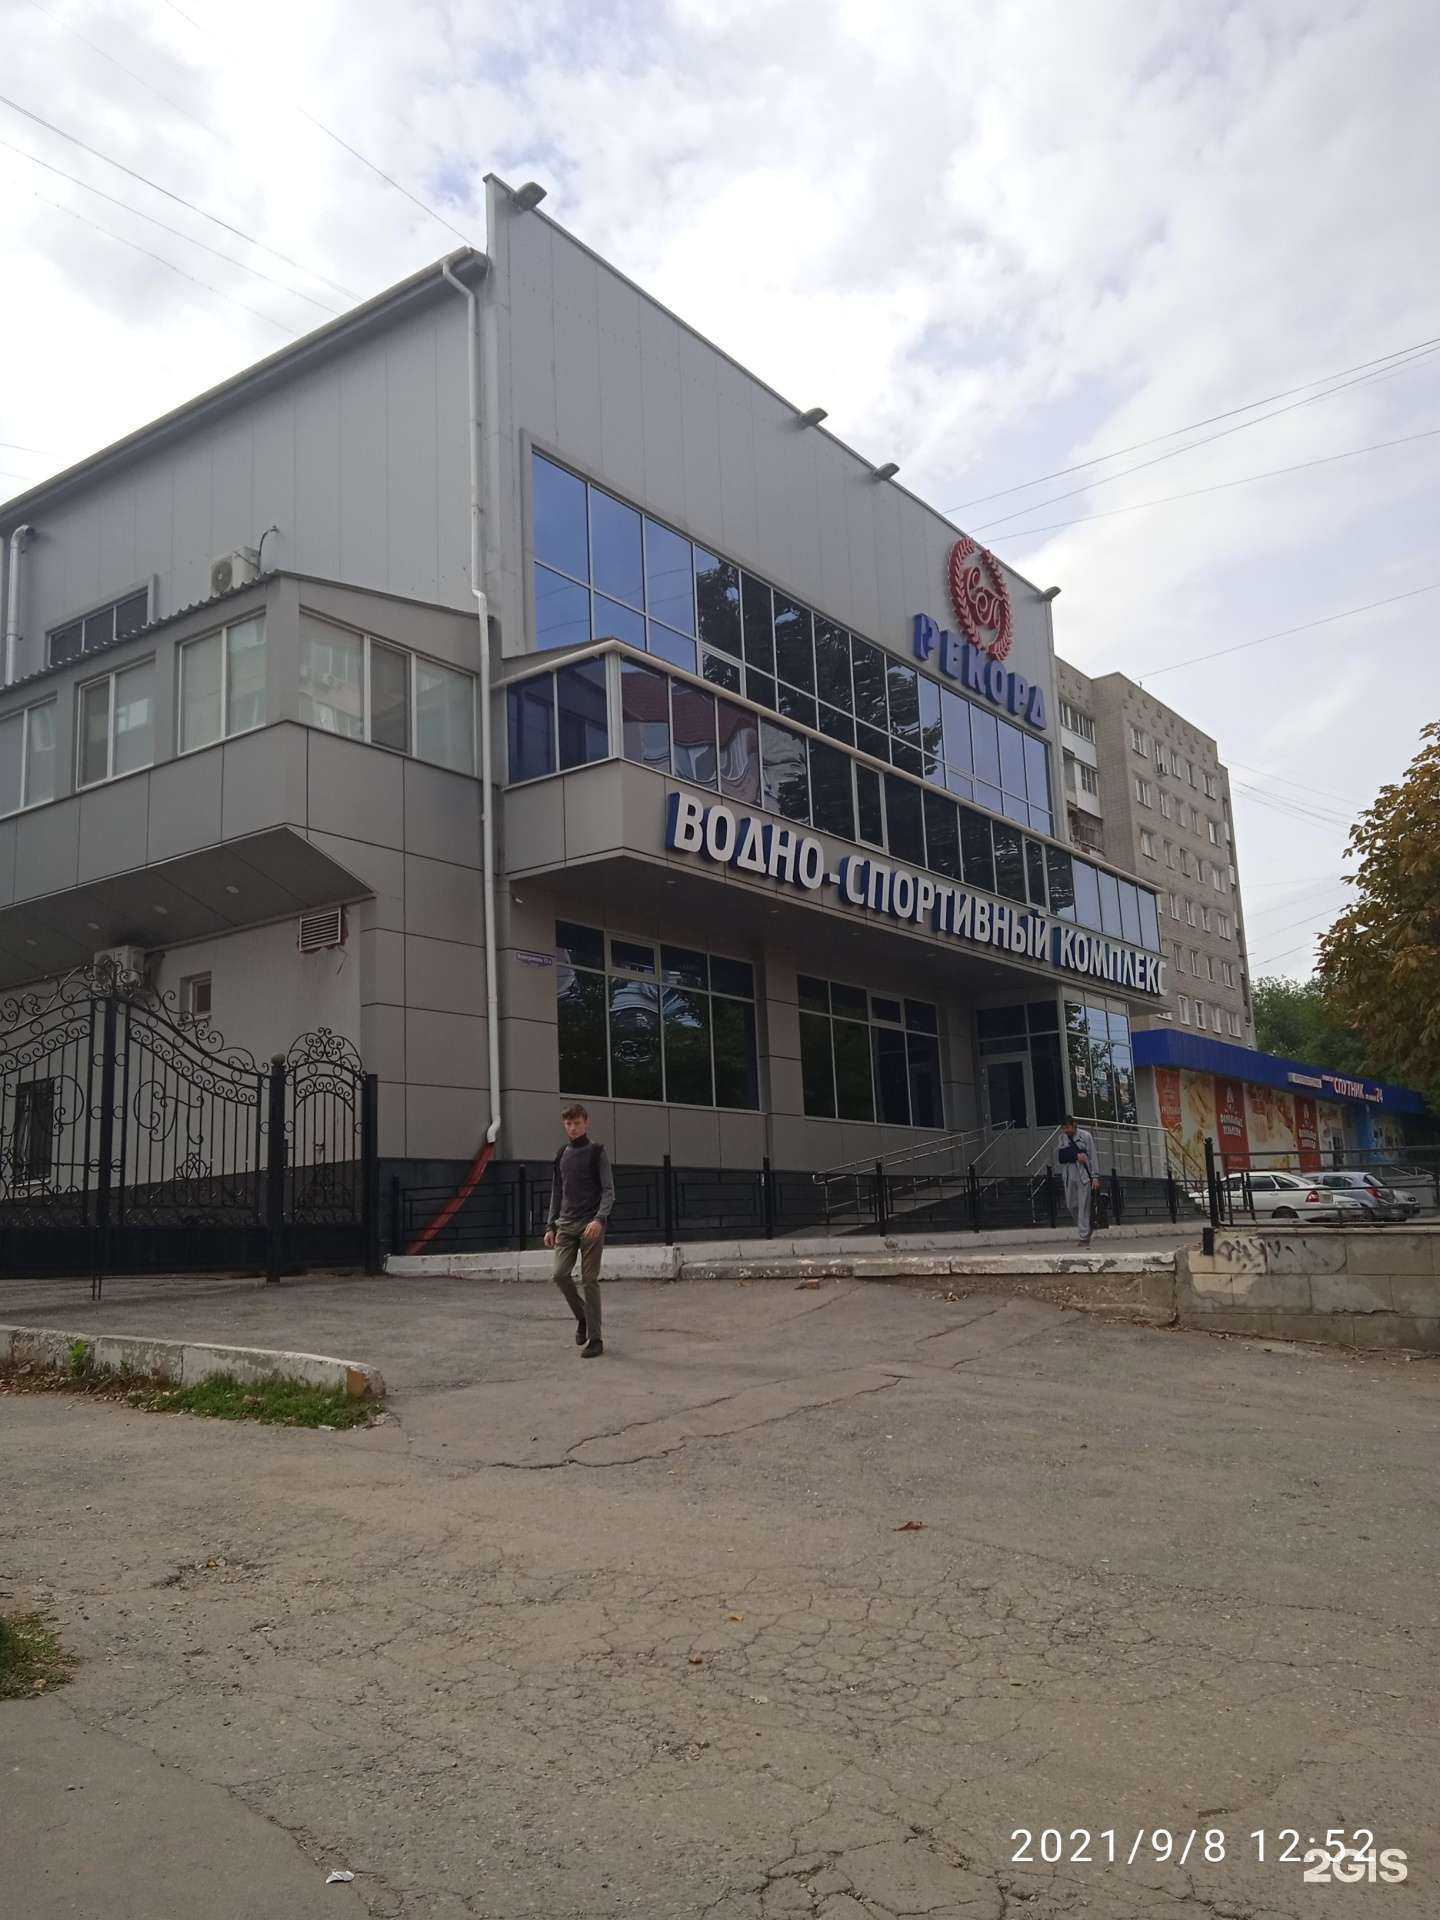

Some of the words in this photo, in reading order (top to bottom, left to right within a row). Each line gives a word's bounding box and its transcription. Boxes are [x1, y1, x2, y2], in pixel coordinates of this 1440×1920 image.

[914, 613, 1048, 731] РЕКОРД
[667, 791, 1054, 960] ВОДНО-СПОРТИВНЫЙ
[1054, 925, 1168, 996] КОМПЛЕКС
